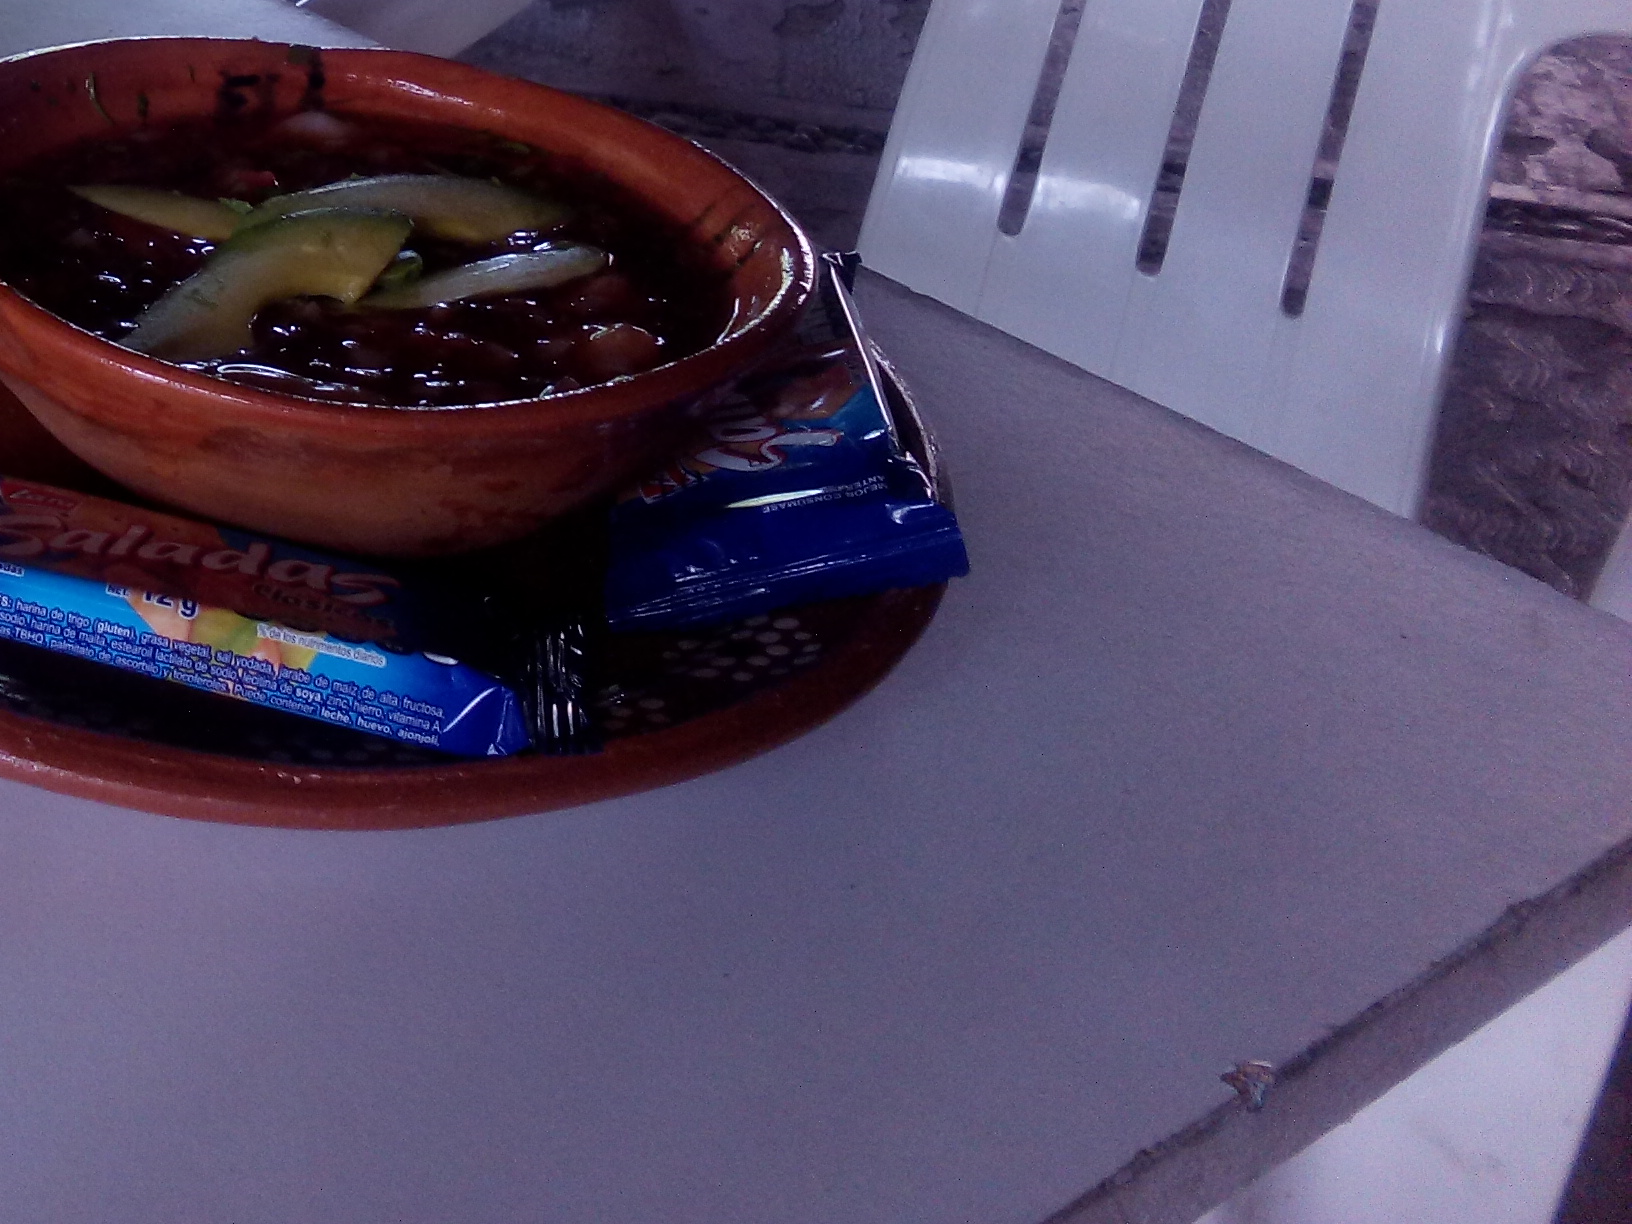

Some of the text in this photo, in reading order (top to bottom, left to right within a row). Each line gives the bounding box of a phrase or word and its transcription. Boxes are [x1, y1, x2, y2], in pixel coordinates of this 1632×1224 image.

[15, 596, 47, 617] harina
[51, 607, 64, 621] de
[67, 612, 90, 629] trigo
[141, 632, 169, 648] grasa
[314, 675, 329, 689] de
[361, 686, 376, 700] de
[378, 690, 398, 706] alta
[30, 618, 61, 635] harina
[63, 626, 76, 639] de
[194, 658, 208, 672] de
[279, 681, 293, 694] de
[388, 711, 430, 731] vitamina
[98, 649, 111, 661] de
[233, 682, 267, 701] Puede
[269, 628, 282, 640] de
[282, 630, 296, 644] los
[298, 635, 352, 658] nutrimentos
